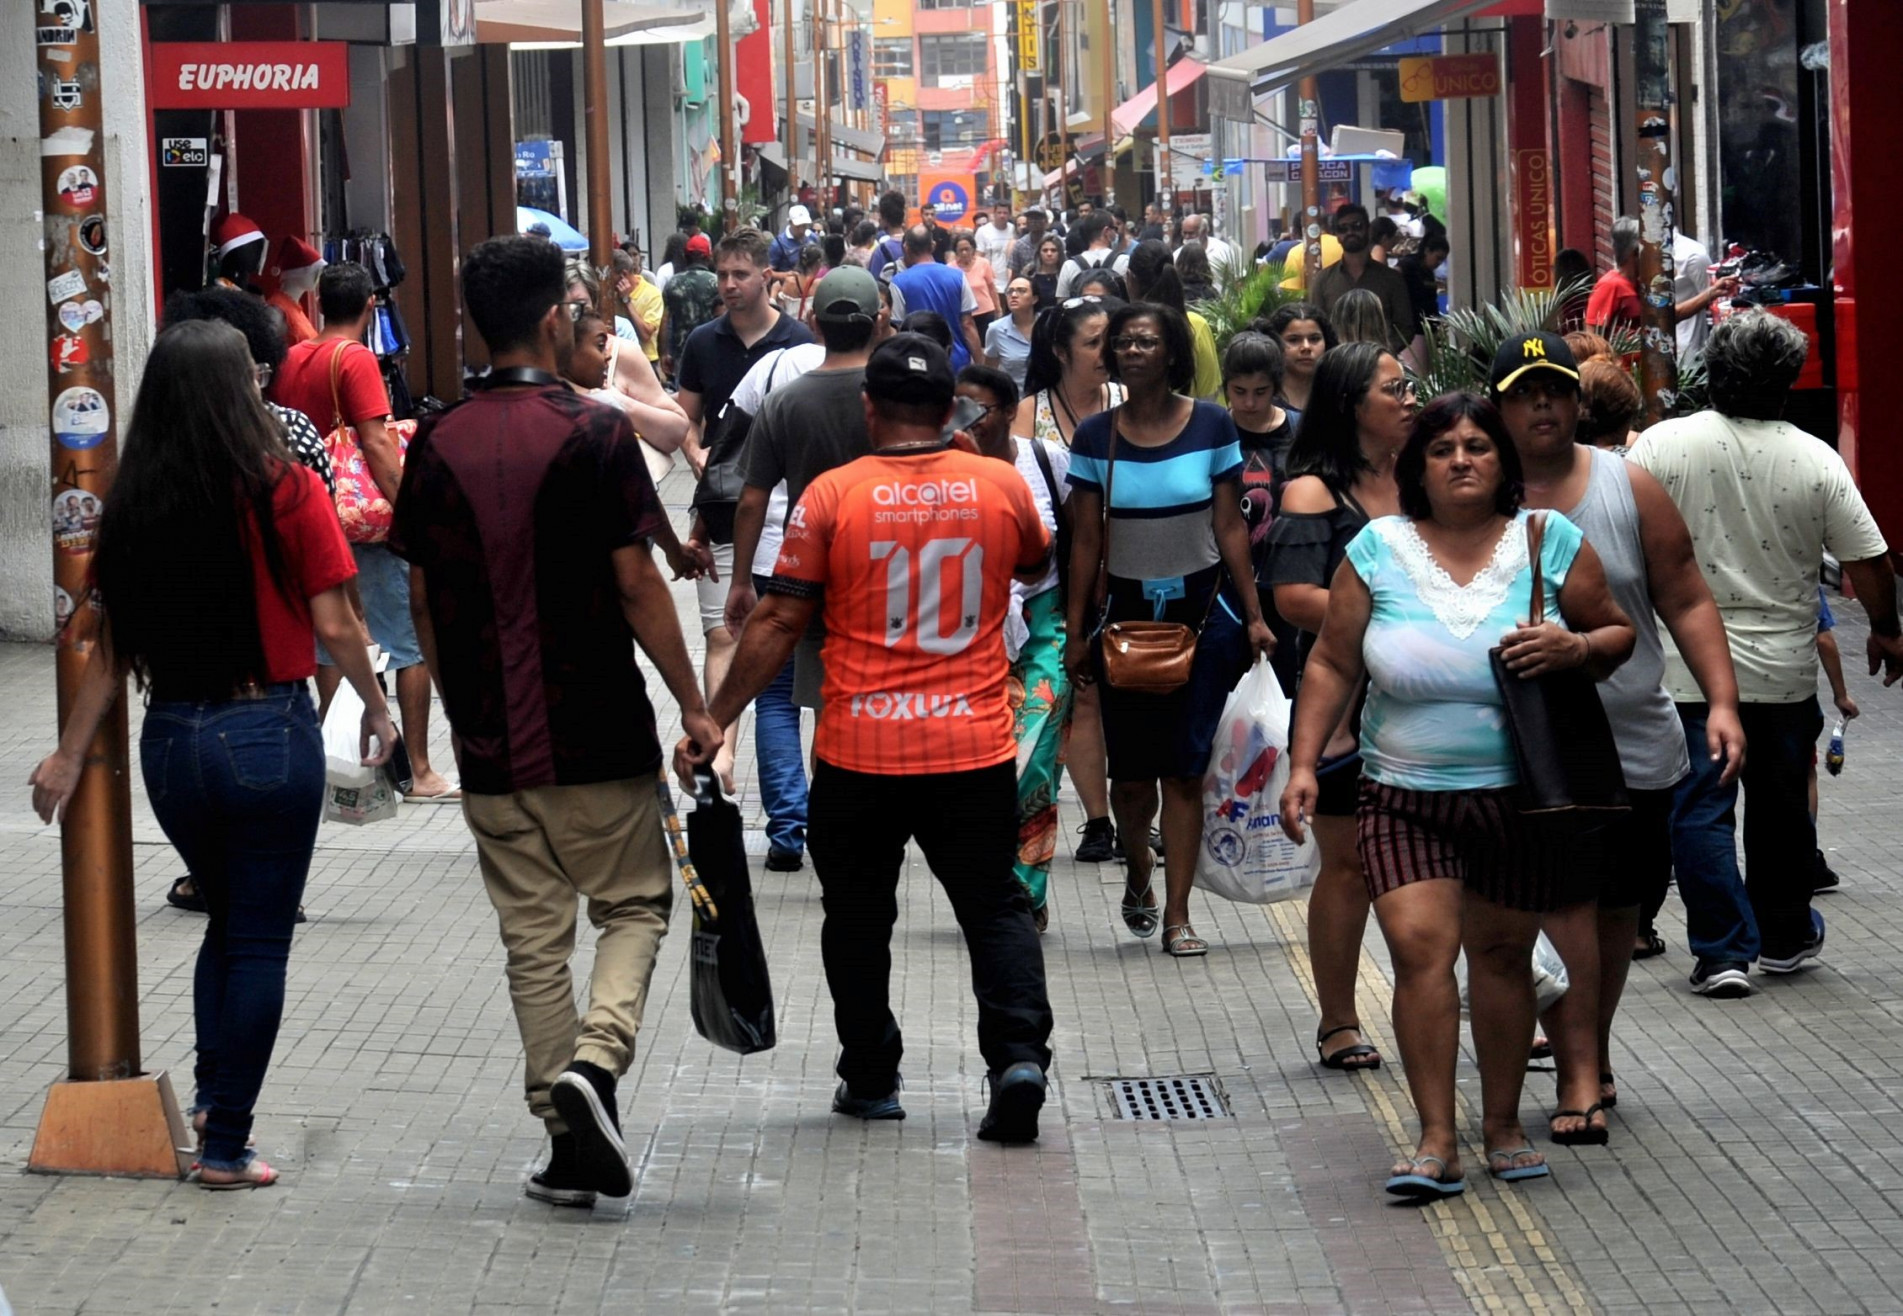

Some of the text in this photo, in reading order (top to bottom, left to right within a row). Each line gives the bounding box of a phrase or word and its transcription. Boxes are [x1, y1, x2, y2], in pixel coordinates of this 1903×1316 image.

[178, 63, 319, 91] EUPHORIA
[1528, 154, 1548, 284] ÓTICAS ÚNICO
[873, 479, 977, 505] alcatel
[875, 507, 979, 525] smartphones
[870, 538, 983, 655] 10
[851, 692, 973, 720] FOXLUX
